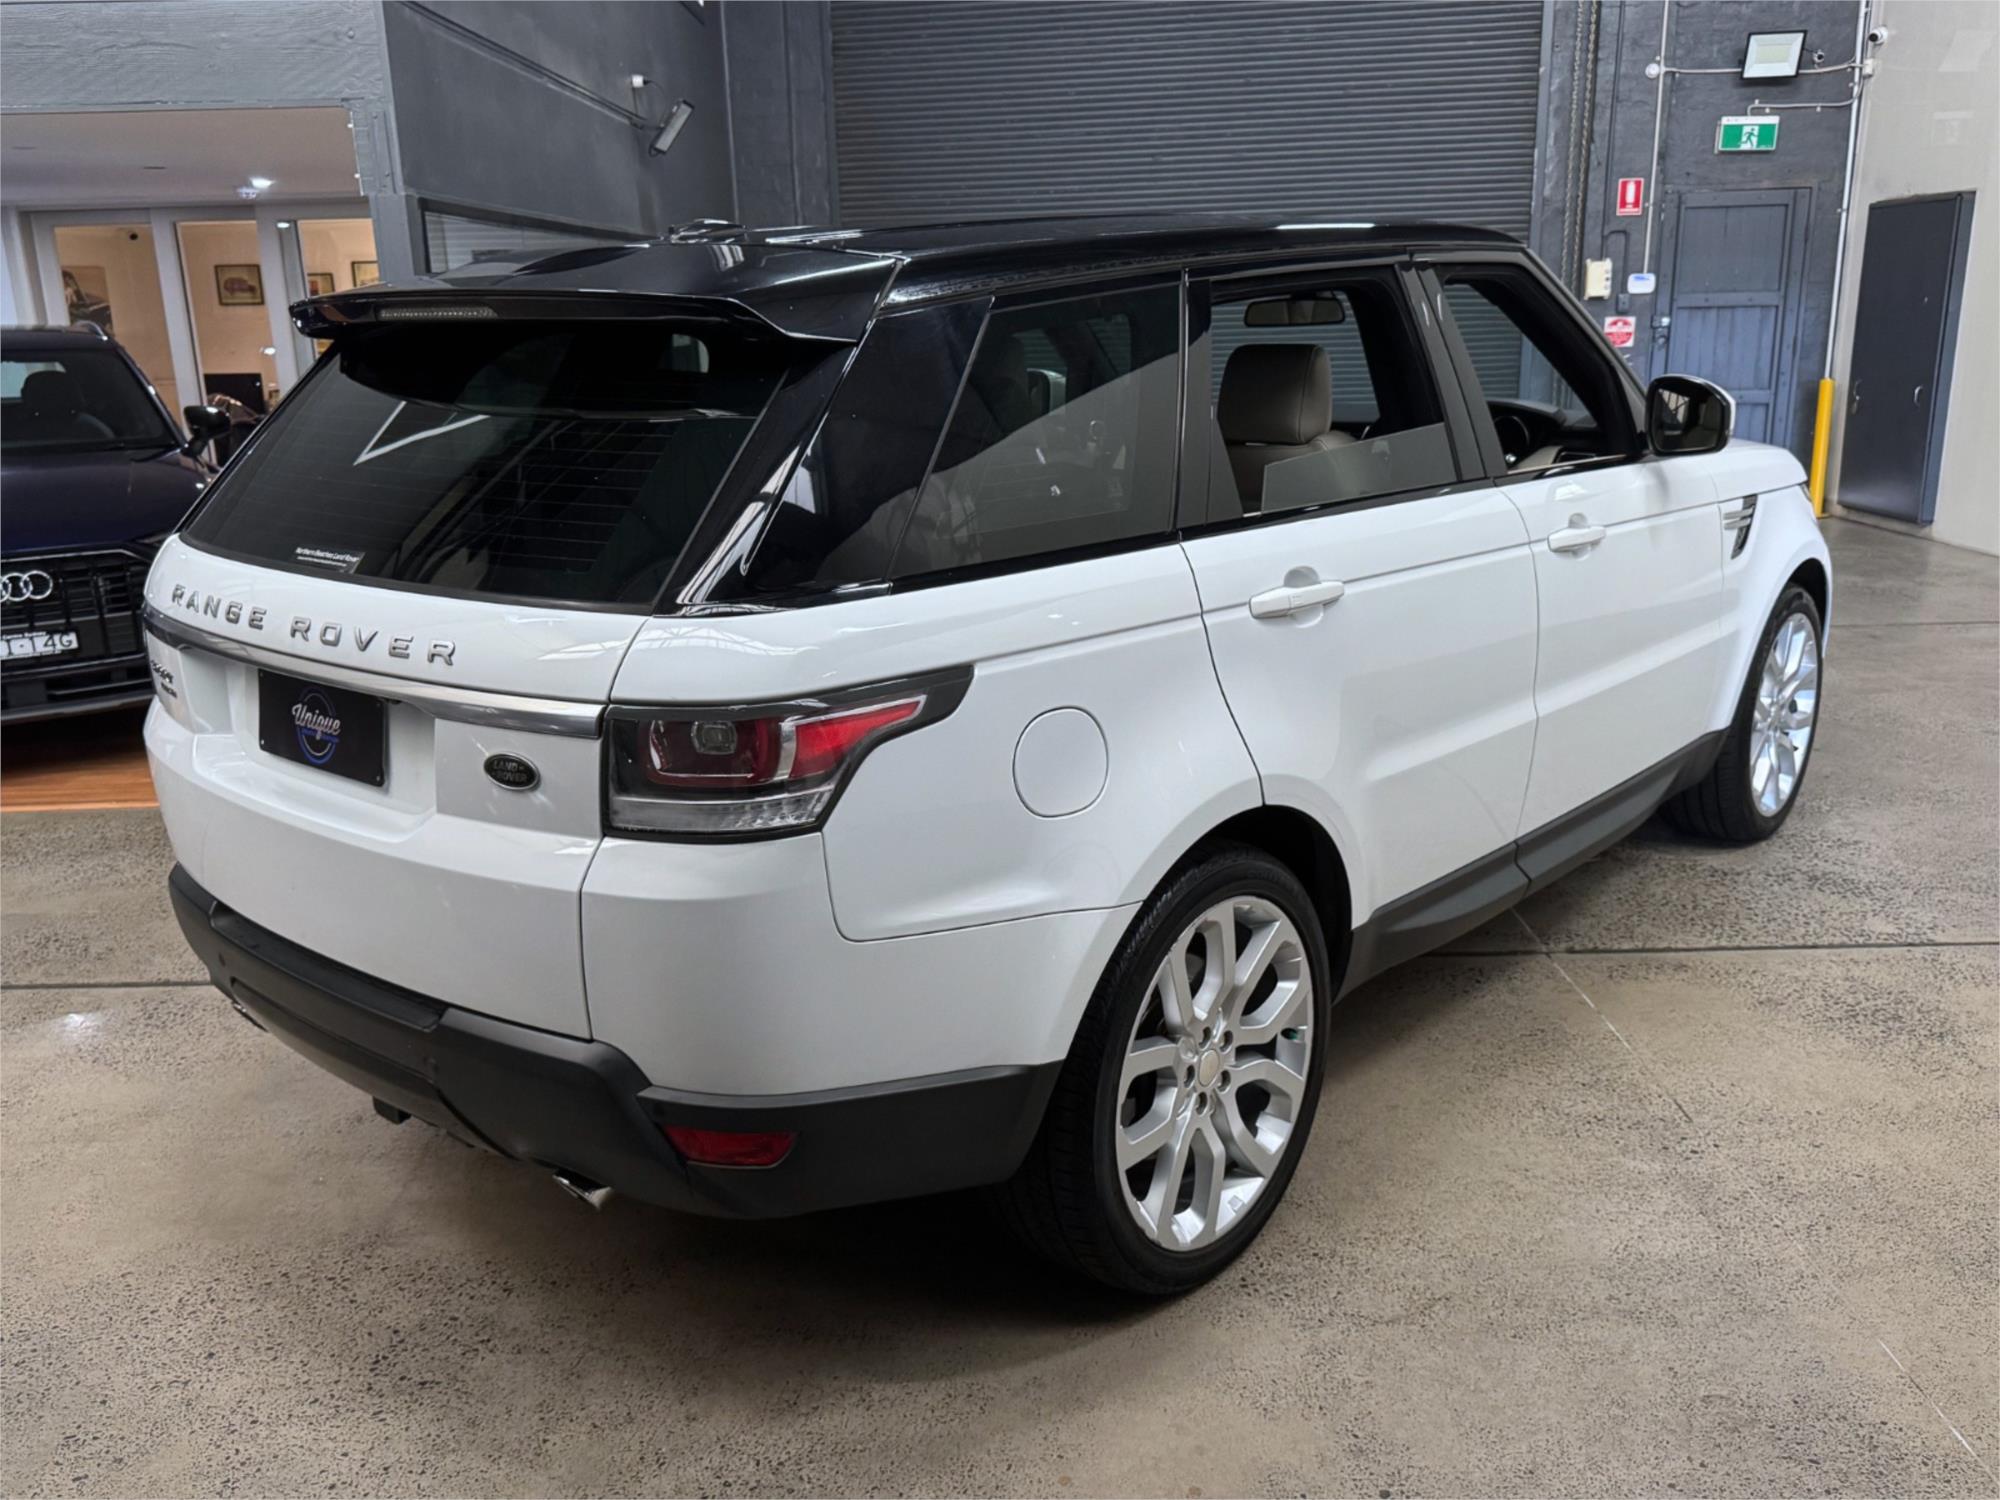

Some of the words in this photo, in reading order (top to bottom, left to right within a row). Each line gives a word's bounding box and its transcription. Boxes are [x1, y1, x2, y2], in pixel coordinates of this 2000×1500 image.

[172, 583, 267, 631] RANGE
[290, 616, 456, 666] ROVER
[291, 702, 342, 740] Unique
